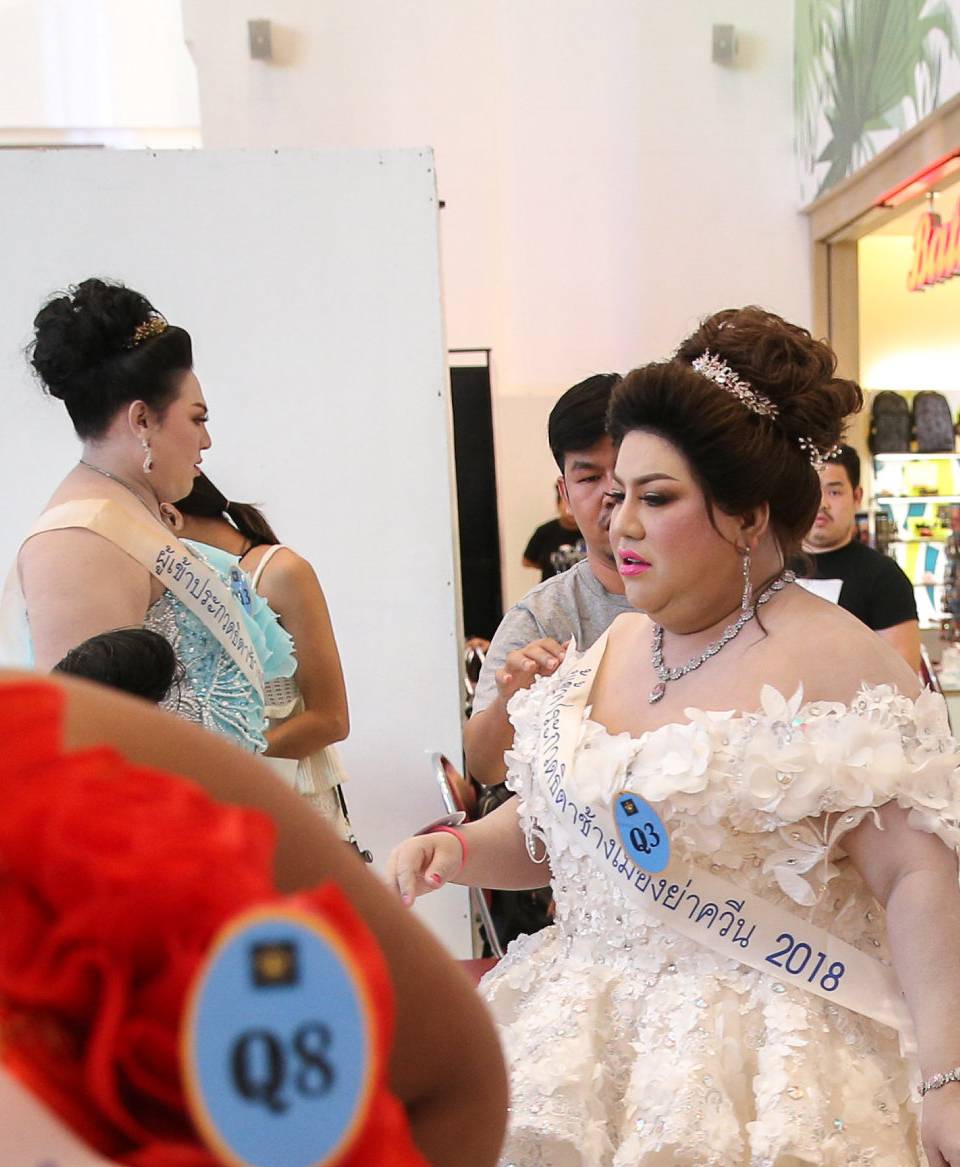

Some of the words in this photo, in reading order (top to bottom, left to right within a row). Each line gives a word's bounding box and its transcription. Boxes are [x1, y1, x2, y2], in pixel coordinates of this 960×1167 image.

[629, 821, 661, 854] Q3
[764, 931, 847, 993] 2018
[229, 1021, 335, 1113] Q8
